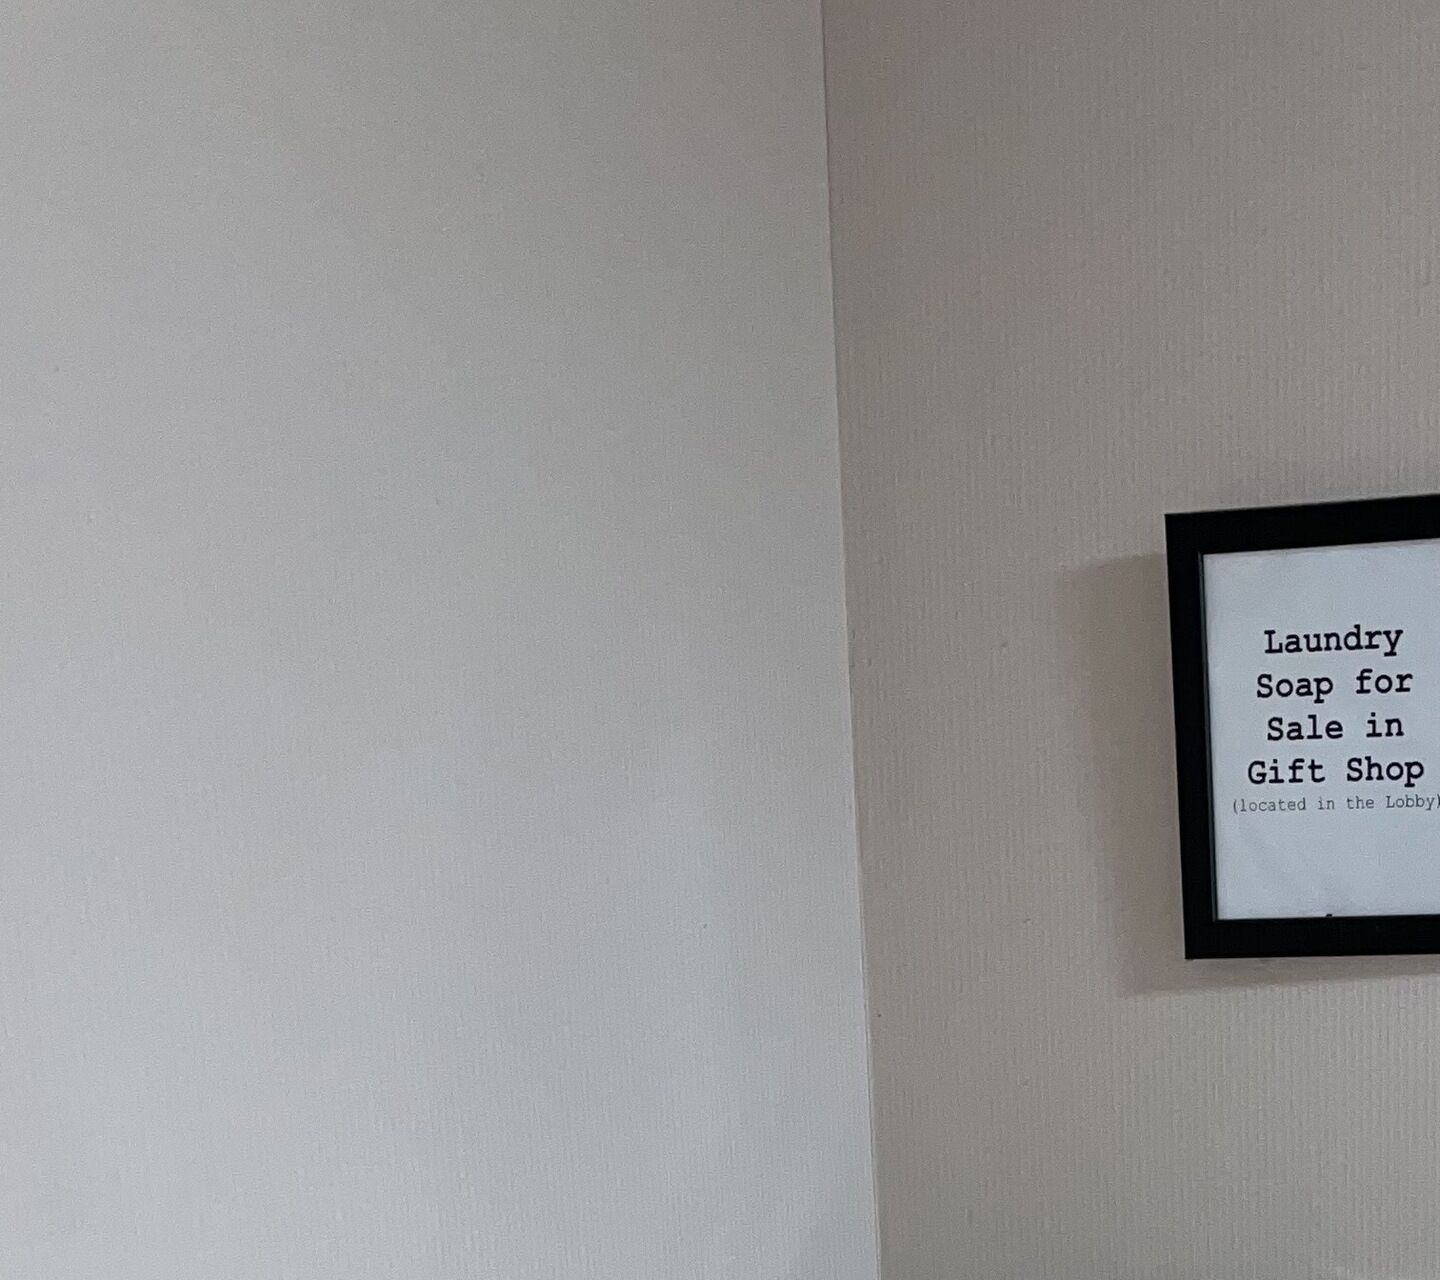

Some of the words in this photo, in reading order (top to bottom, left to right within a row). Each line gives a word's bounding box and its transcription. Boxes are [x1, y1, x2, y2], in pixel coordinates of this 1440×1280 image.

[1264, 624, 1403, 657] Laundry
[1256, 674, 1334, 704] Soap
[1355, 668, 1413, 695] for
[1267, 714, 1343, 741] Sale
[1366, 712, 1404, 738] in
[1247, 759, 1326, 784] Gift
[1346, 756, 1425, 788] Shop
[1232, 797, 1307, 814] (located
[1317, 796, 1336, 810] in
[1346, 796, 1375, 810] the
